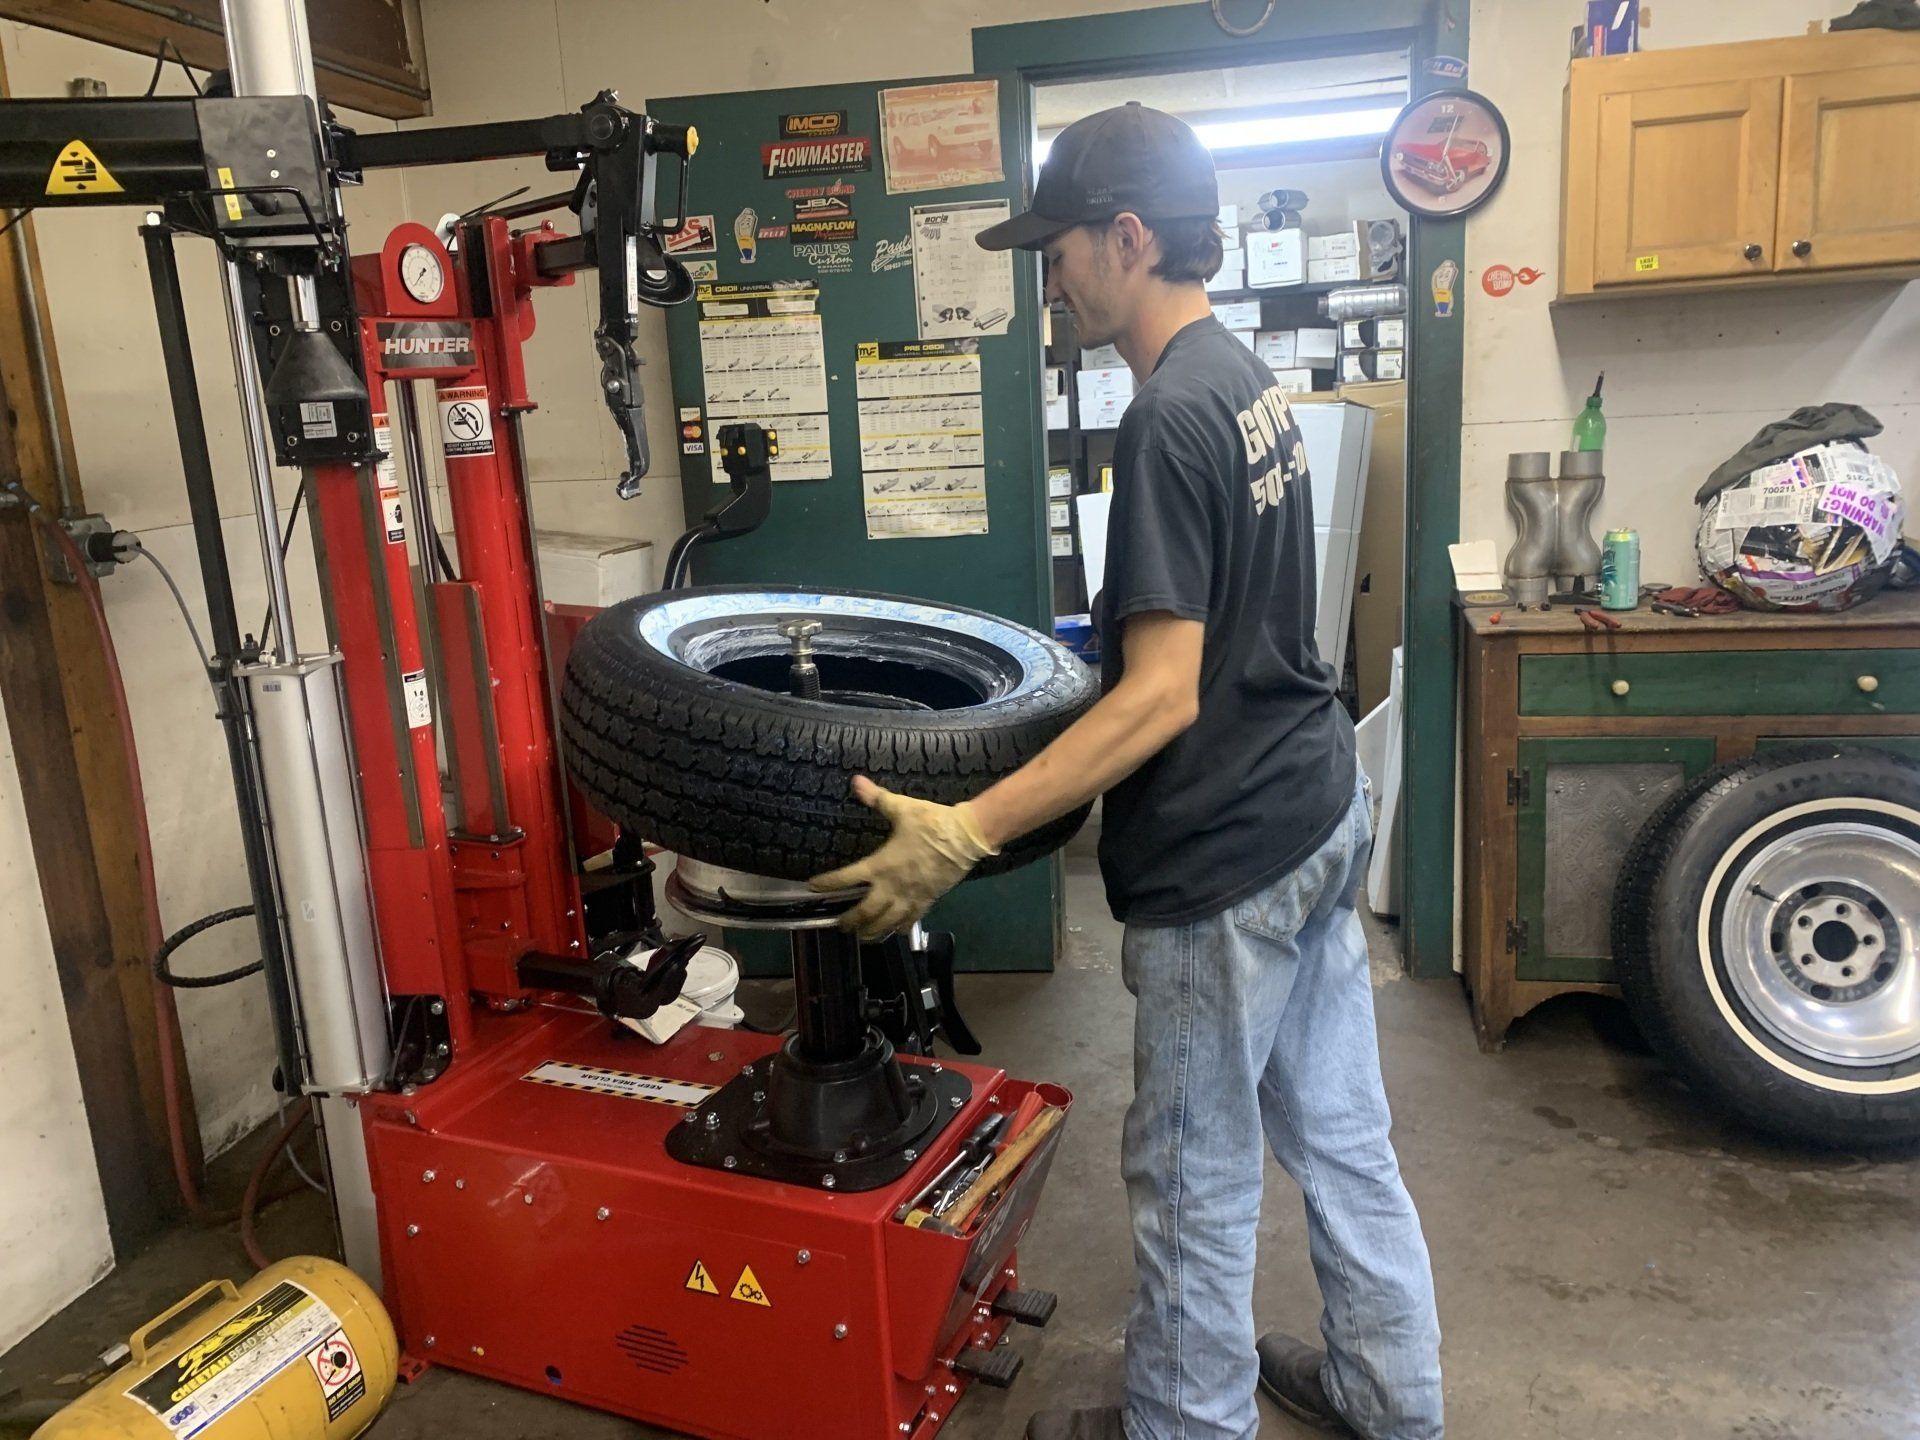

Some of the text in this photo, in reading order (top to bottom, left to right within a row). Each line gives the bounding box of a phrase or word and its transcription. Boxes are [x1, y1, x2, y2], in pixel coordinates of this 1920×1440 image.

[1441, 104, 1454, 113] 12
[789, 114, 838, 130] IMCO
[768, 142, 864, 176] FLOWMASTER
[796, 197, 848, 208] JBA
[791, 221, 855, 232] MAGNAFLOW
[794, 243, 851, 257] PAUL'S
[809, 254, 853, 265] Custom
[385, 337, 469, 354] HUNTER
[446, 389, 485, 399] WARNING
[686, 444, 703, 452] VISA
[1763, 485, 1796, 495] 700215
[1829, 484, 1876, 511] DO NOT
[1822, 497, 1885, 538] WARNING!
[580, 1073, 663, 1090] KEEP AREA CLEAR
[171, 1355, 232, 1403] CHEETAH
[227, 1337, 257, 1362] BEAD
[256, 1311, 293, 1339] SEATER
[328, 1374, 362, 1406] DO NOT DROP
